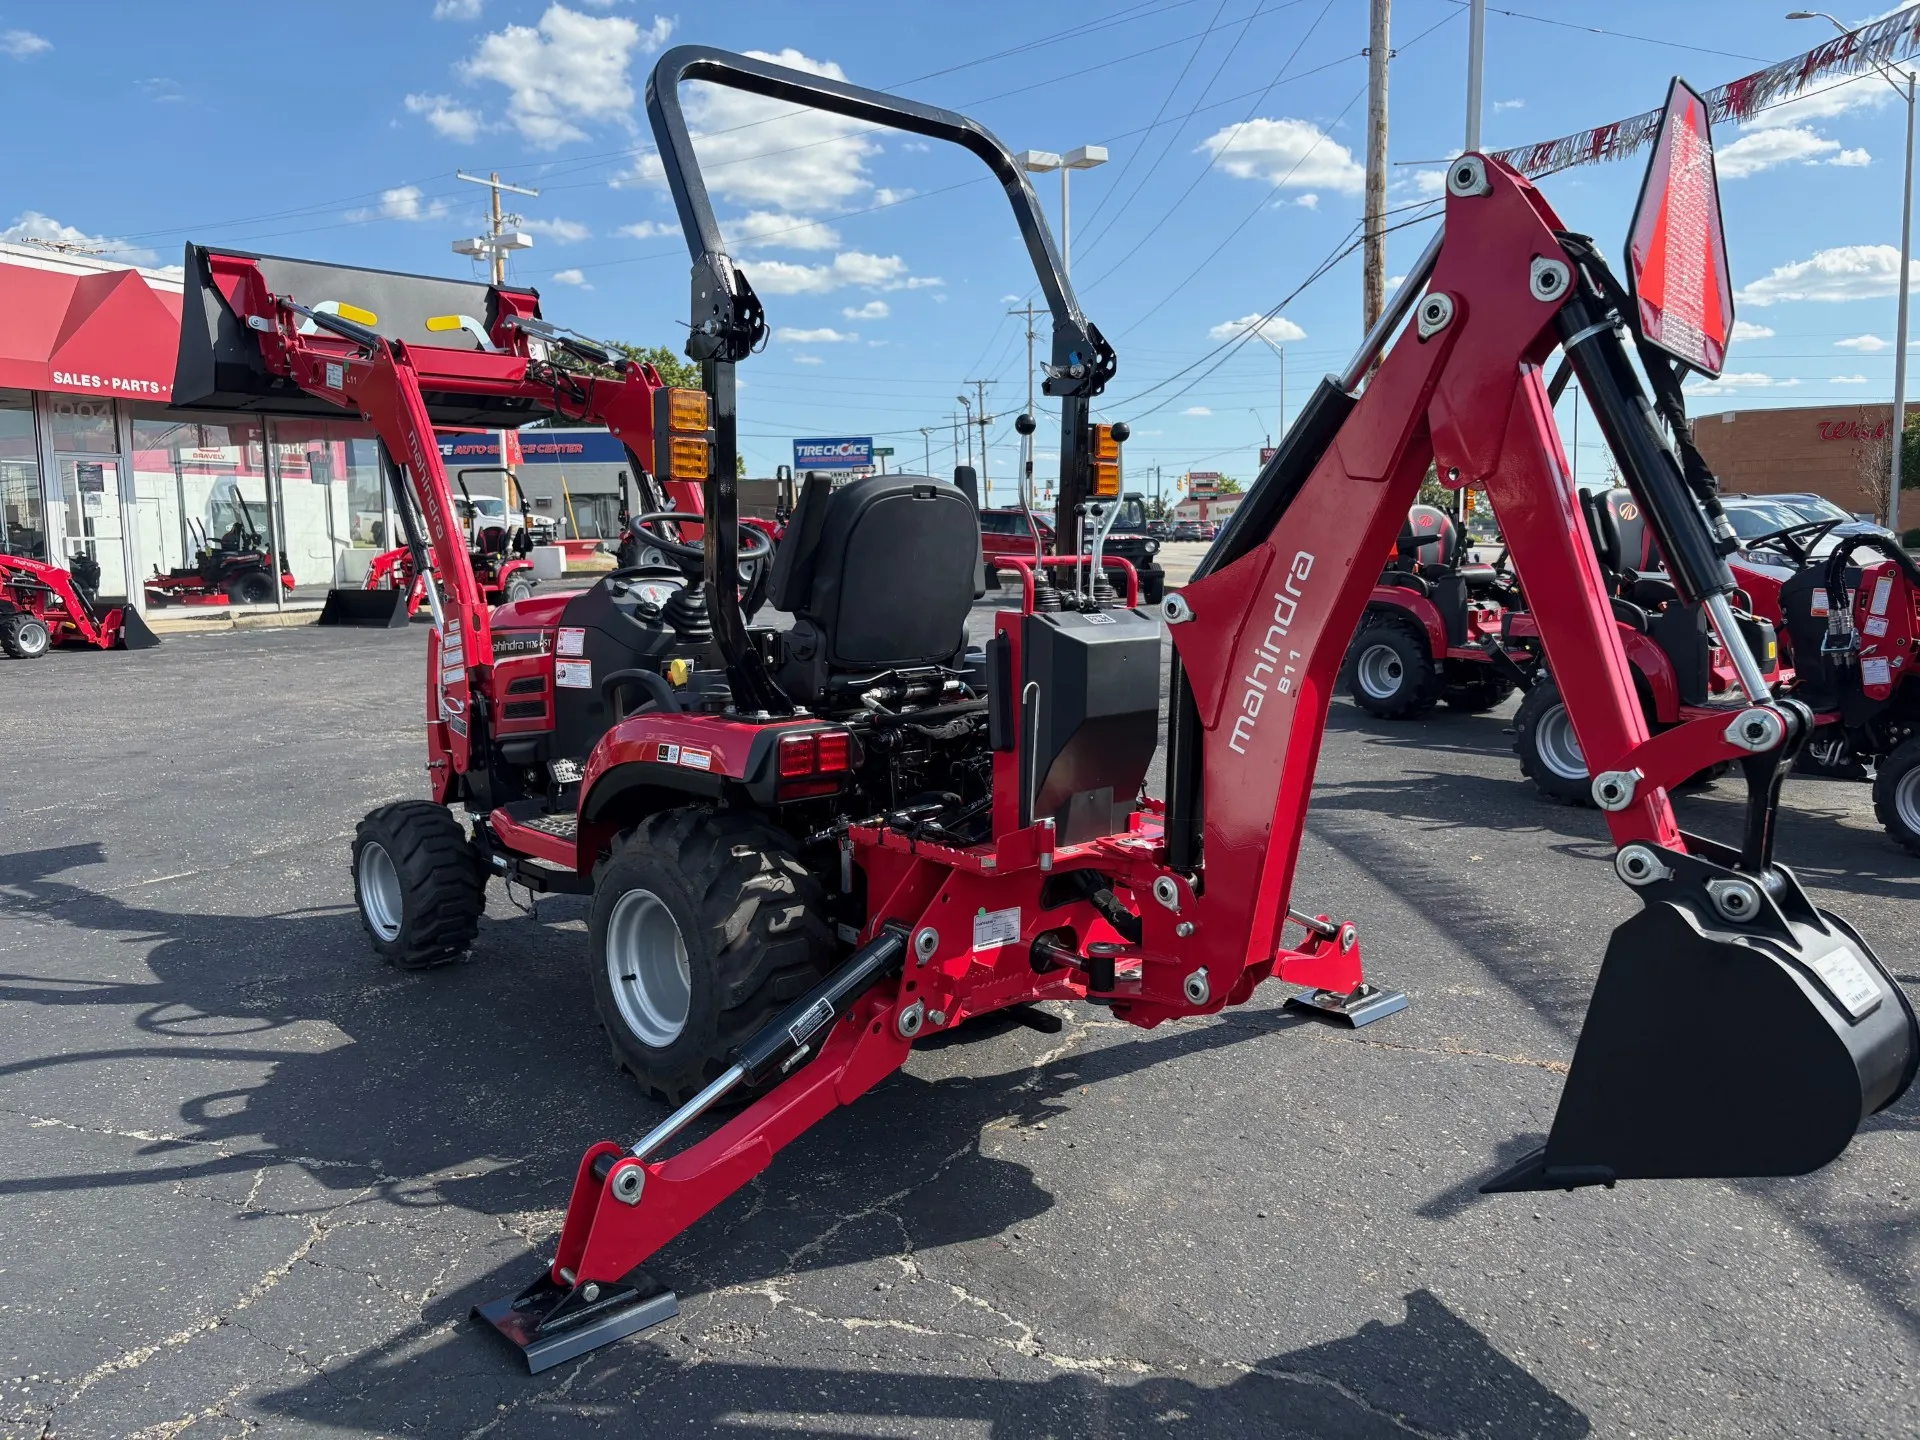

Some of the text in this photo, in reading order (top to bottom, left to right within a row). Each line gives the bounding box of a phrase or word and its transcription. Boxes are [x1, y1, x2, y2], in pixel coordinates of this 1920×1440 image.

[53, 371, 159, 394] SALES PARTS
[346, 375, 357, 385] L11
[453, 445, 487, 455] AUTO
[537, 443, 583, 453] CENTER
[796, 446, 823, 457] TIRE
[823, 441, 869, 456] CHOICE
[408, 429, 445, 540] mahindra
[492, 639, 524, 652] ahindra
[1228, 550, 1315, 755] mahindra
[1276, 650, 1300, 695] B11
